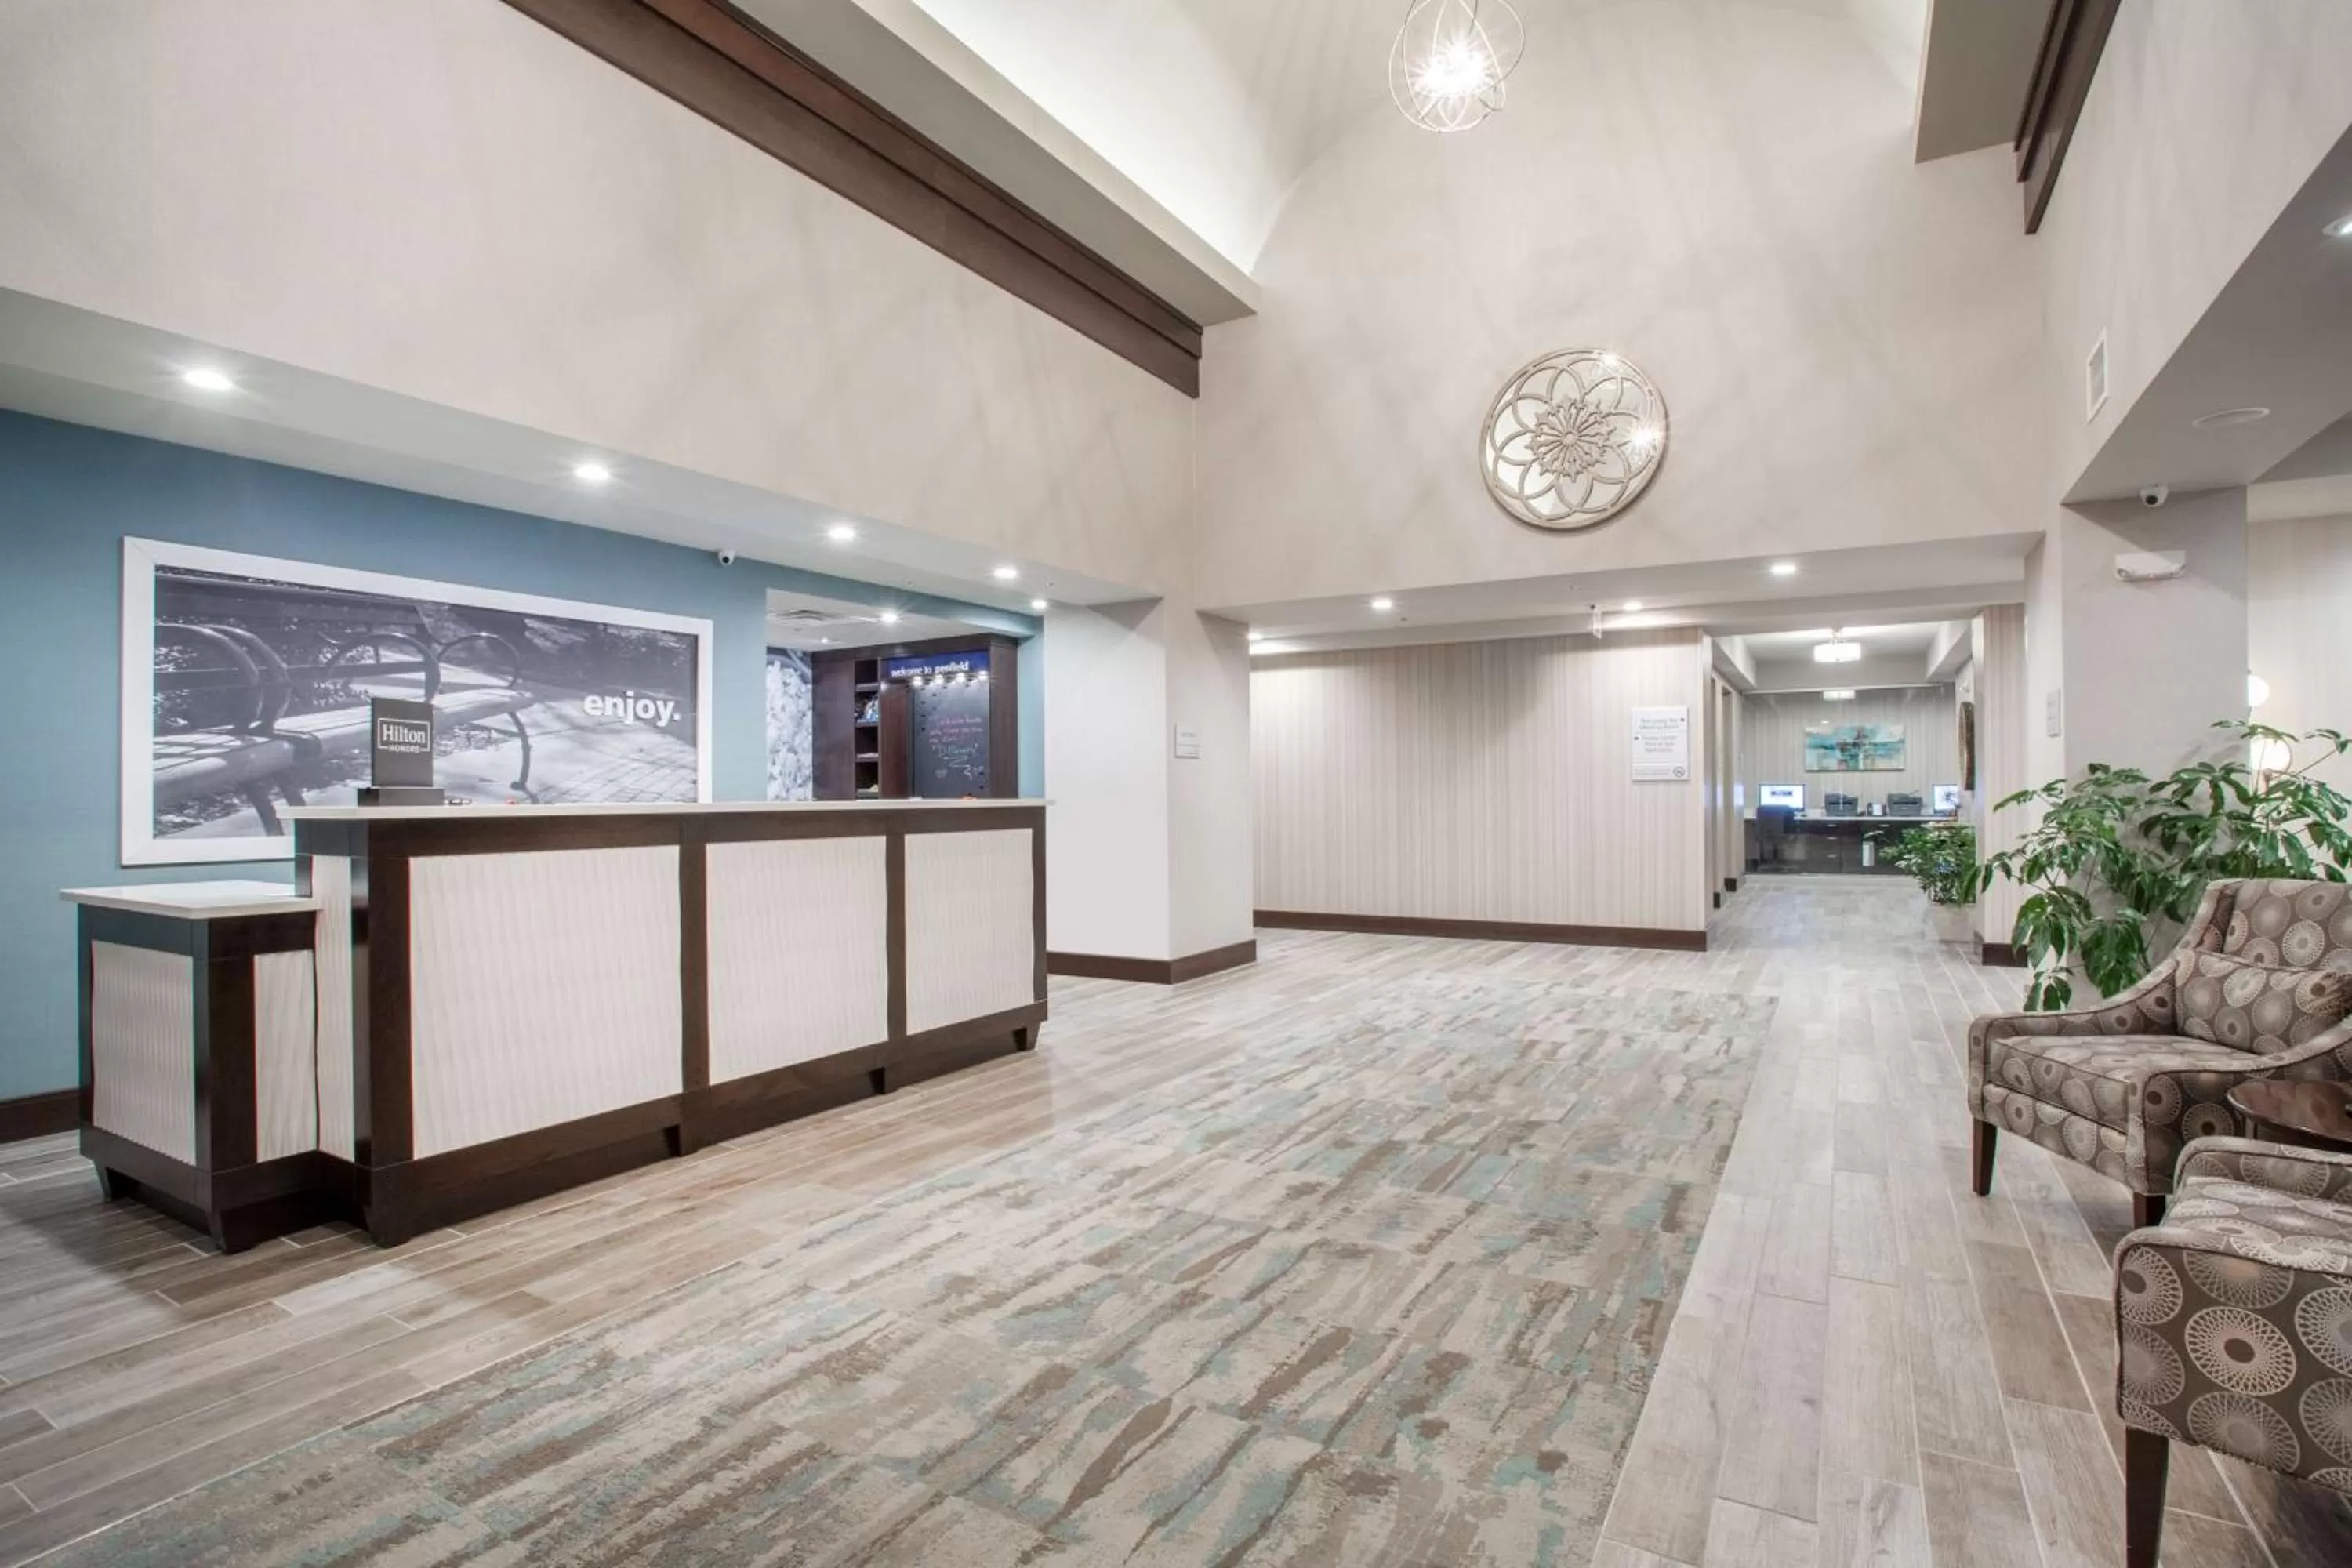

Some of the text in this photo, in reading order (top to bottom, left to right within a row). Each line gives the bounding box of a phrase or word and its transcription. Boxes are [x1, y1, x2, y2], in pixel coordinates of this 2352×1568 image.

[891, 667, 923, 677] welcome
[924, 666, 932, 675] to
[583, 690, 681, 728] enjoy.
[383, 724, 426, 744] Hilton
